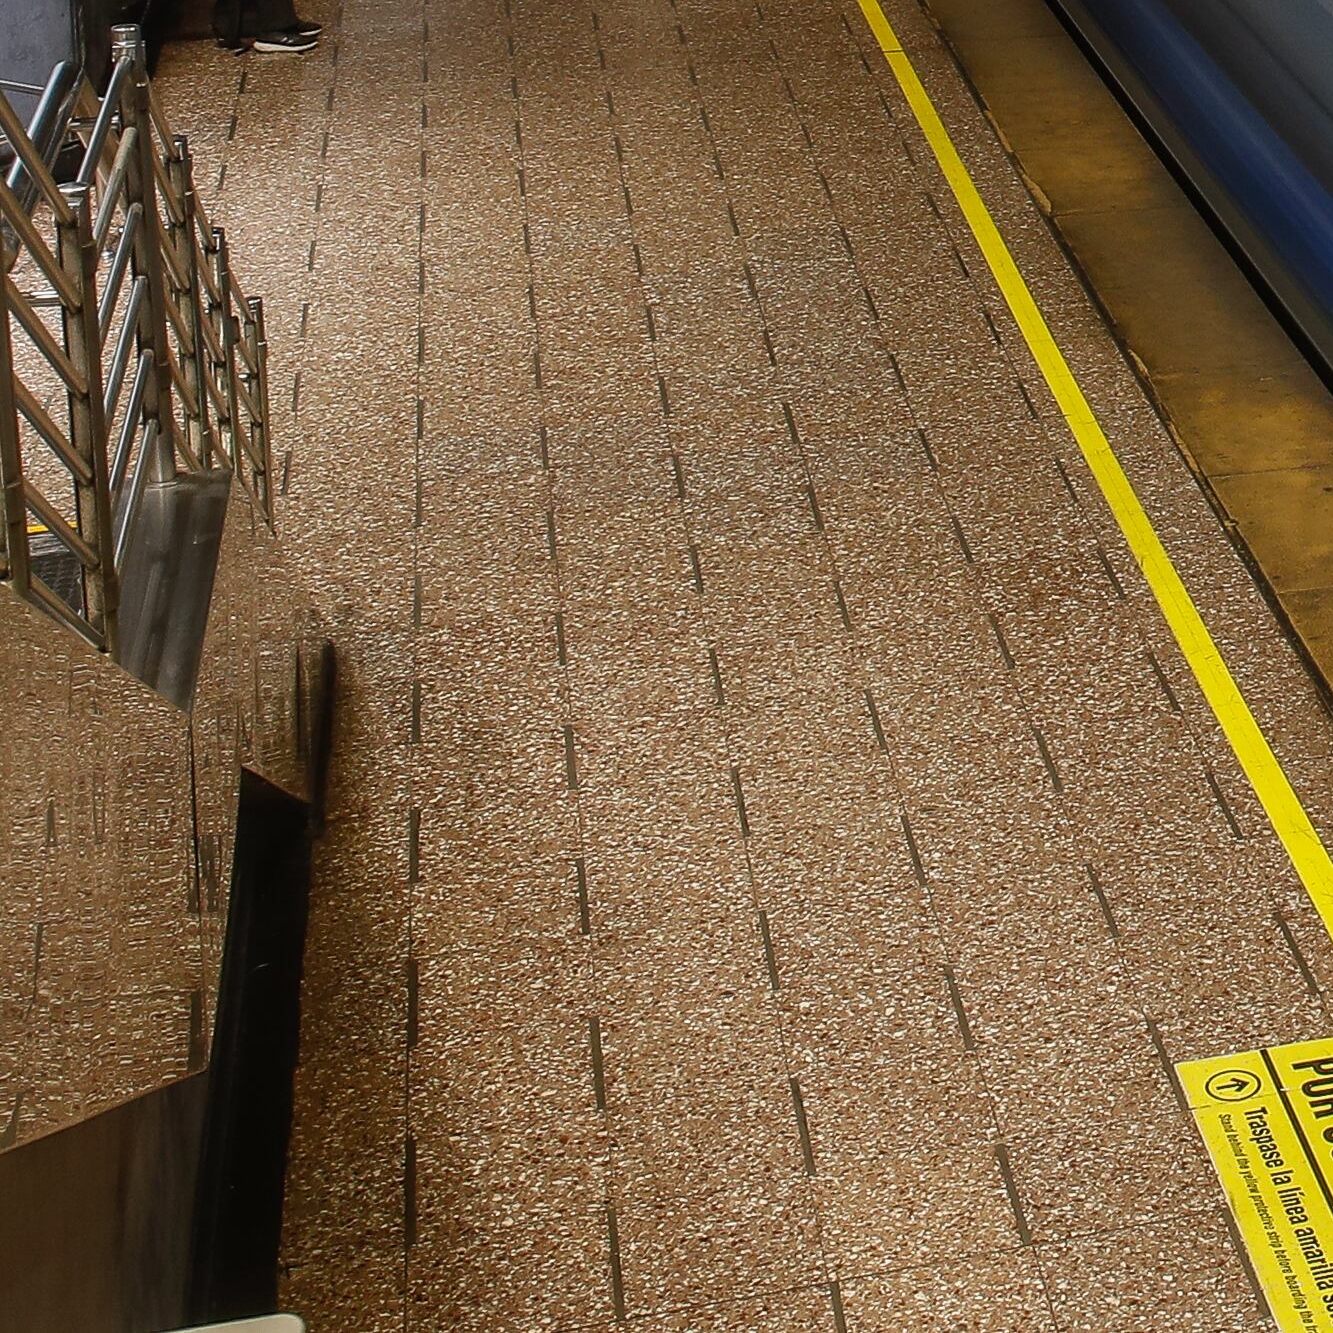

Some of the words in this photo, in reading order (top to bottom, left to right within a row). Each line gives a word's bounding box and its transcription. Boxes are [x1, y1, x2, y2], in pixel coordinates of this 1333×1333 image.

[1219, 1113, 1237, 1132] Stand
[1227, 1133, 1248, 1156] behind
[1244, 1106, 1284, 1168] Traspase
[1237, 1158, 1250, 1169] the
[1239, 1170, 1260, 1193] yellow
[1270, 1169, 1294, 1186] la
[1248, 1194, 1274, 1230] protective
[1277, 1186, 1308, 1225] línea
[1266, 1231, 1283, 1248] strip
[1274, 1249, 1293, 1274] before
[1285, 1275, 1308, 1309] boarding
[1300, 1311, 1313, 1323] the
